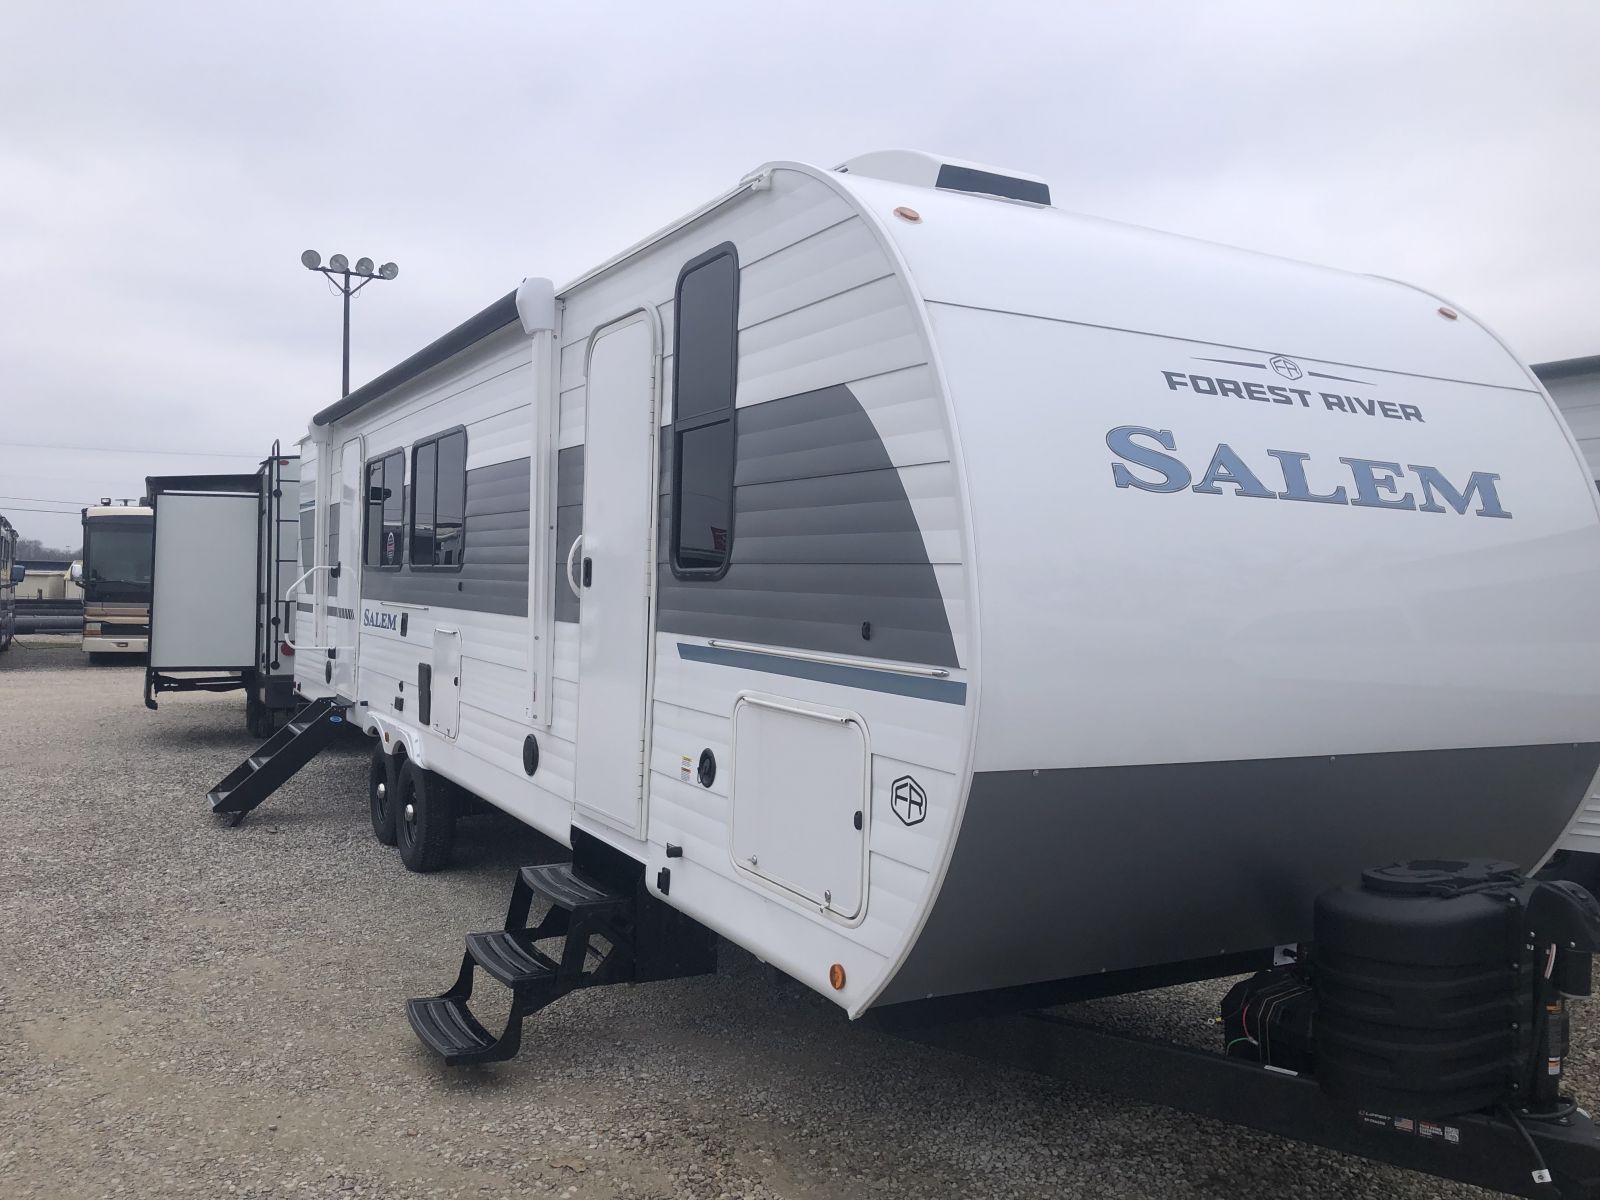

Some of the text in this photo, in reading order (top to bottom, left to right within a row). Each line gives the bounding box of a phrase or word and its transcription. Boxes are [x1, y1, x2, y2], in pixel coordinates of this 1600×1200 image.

[1161, 370, 1425, 423] FOREST RIVER
[1105, 425, 1513, 519] SALEM
[363, 608, 397, 631] SALEM
